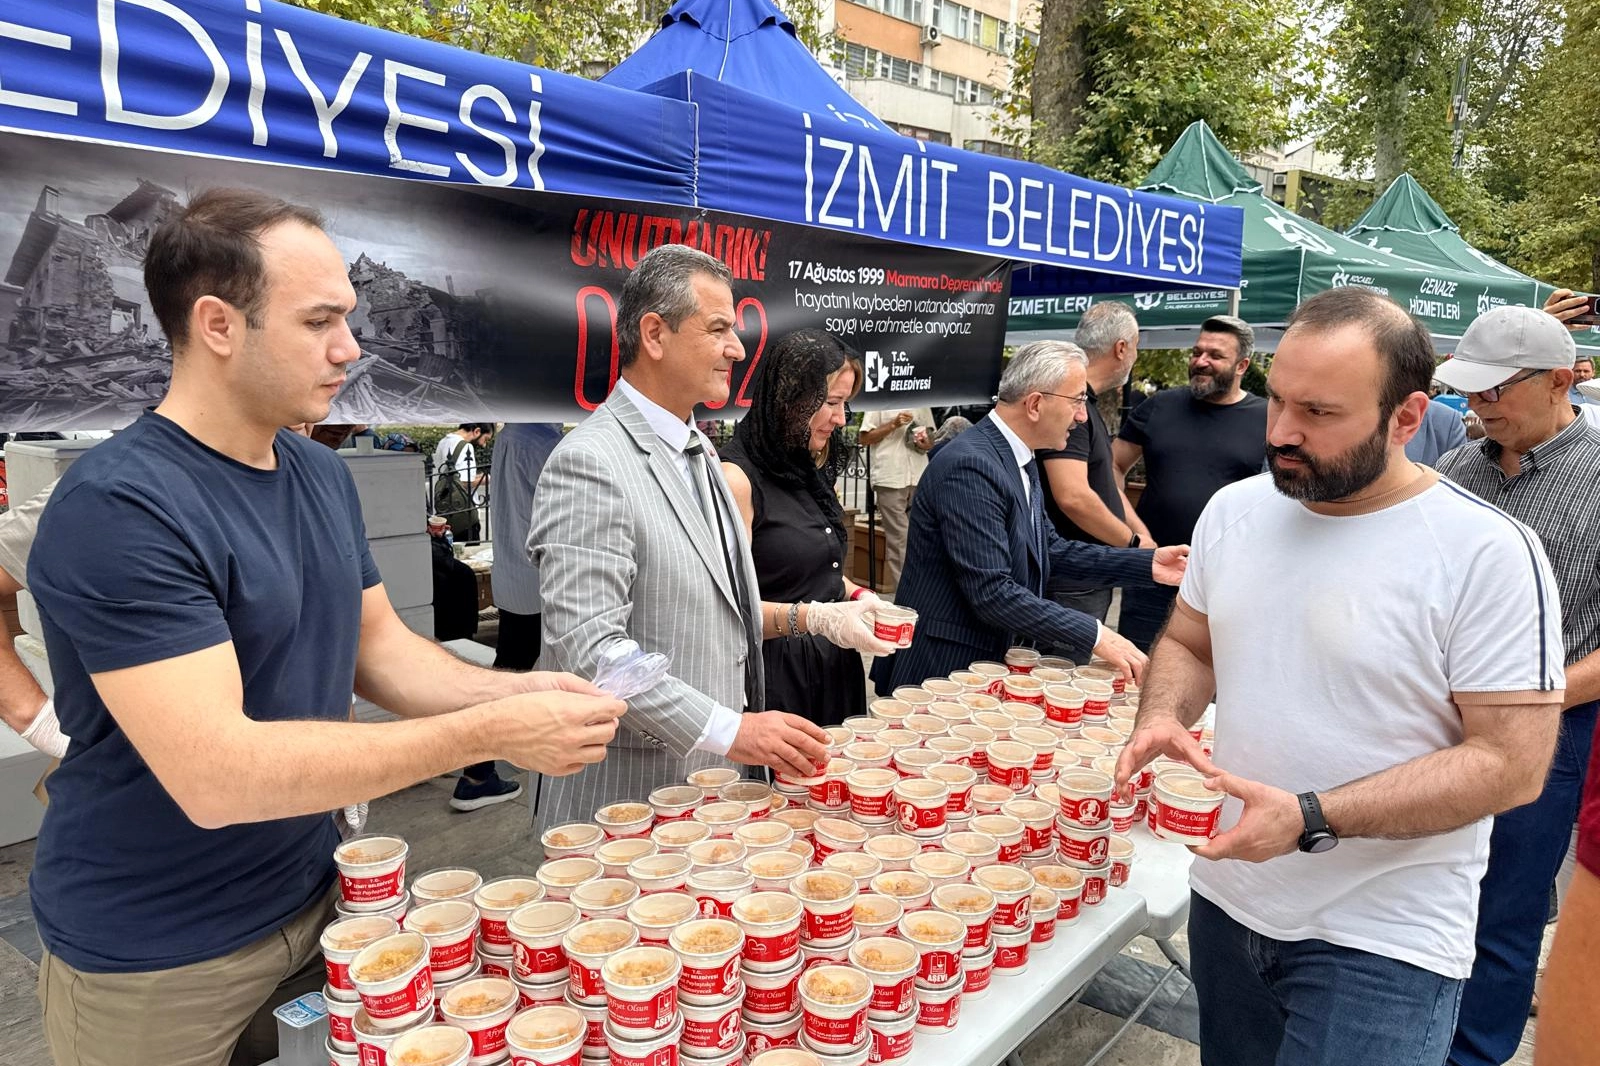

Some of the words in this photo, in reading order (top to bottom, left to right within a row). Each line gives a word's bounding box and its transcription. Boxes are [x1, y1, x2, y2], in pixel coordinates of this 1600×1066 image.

[803, 113, 958, 240] İZMİT
[987, 170, 1205, 276] BELEDİYESİ
[788, 260, 803, 279] 17
[803, 262, 856, 285] Ağustos
[858, 267, 885, 285] 1999
[886, 269, 939, 289] Marmara
[940, 274, 1003, 294] Depremi'nde
[1166, 290, 1227, 301] BELEDİYESİ
[1420, 277, 1458, 298] CENAZE
[795, 288, 850, 312] hayatını
[852, 291, 912, 315] kaybeden
[914, 298, 995, 318] vatandaşlarımızı
[1409, 295, 1460, 320] HİZMETLERİ
[825, 317, 857, 336] saygı
[860, 319, 873, 333] ve
[874, 316, 923, 334] rahmetle
[891, 351, 909, 362] T.C.
[891, 365, 914, 376] İZMİT
[890, 376, 932, 391] BELEDİYESİ
[488, 922, 506, 932] Afiye
[829, 1021, 849, 1029] Olsun
